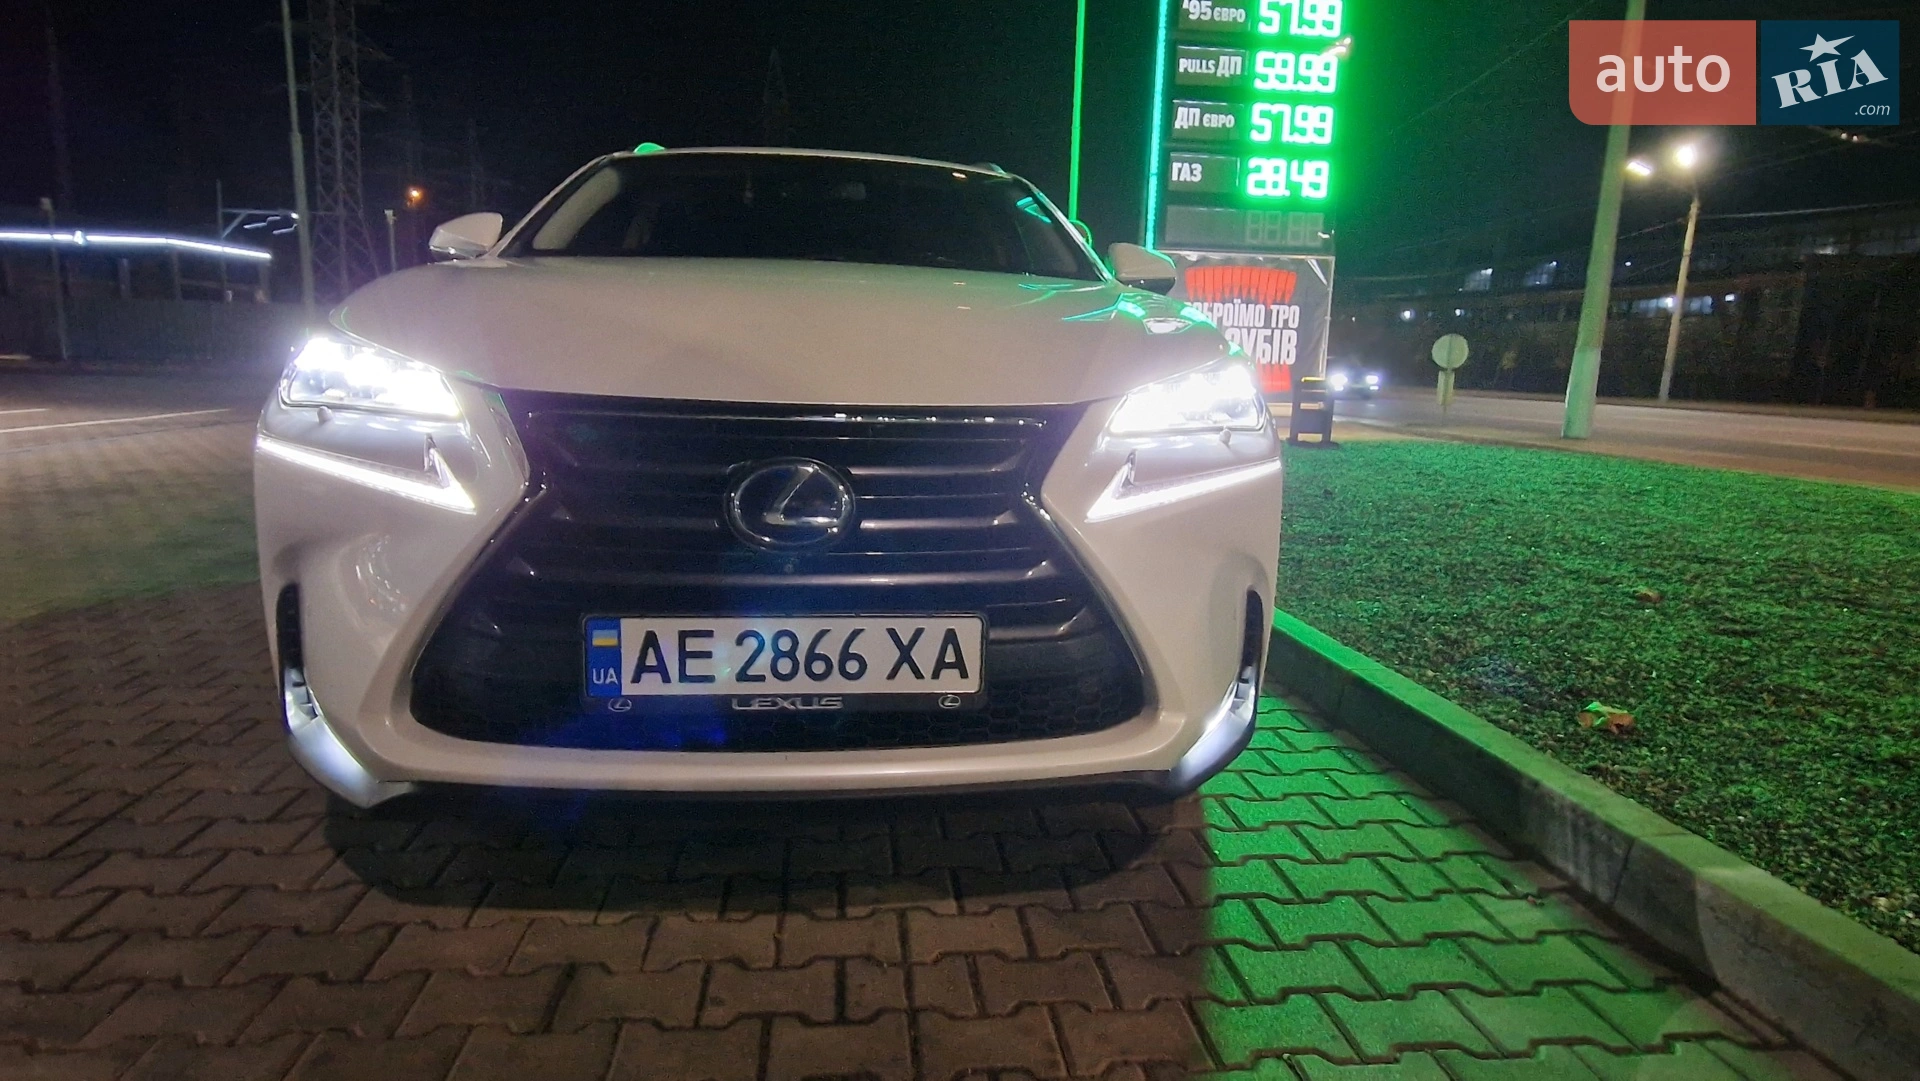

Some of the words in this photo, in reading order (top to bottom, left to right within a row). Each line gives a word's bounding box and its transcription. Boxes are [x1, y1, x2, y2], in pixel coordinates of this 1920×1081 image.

[1213, 7, 1246, 23] ЄВРО
[1258, 0, 1343, 37] 57.99
[1178, 58, 1216, 74] PULLS
[1216, 55, 1243, 78] ДП
[1254, 50, 1339, 93] 59.99
[1174, 106, 1201, 129] ДП
[1202, 113, 1235, 128] ЄВРО
[1250, 102, 1334, 145] 57.99
[1171, 162, 1203, 183] ГАЗ
[1246, 157, 1329, 198] 28.49
[1270, 304, 1300, 329] ТРО
[630, 629, 716, 684] AE
[735, 628, 868, 683] 2866
[885, 627, 970, 681] XA
[592, 668, 619, 686] UA
[731, 696, 844, 710] LEXUS
